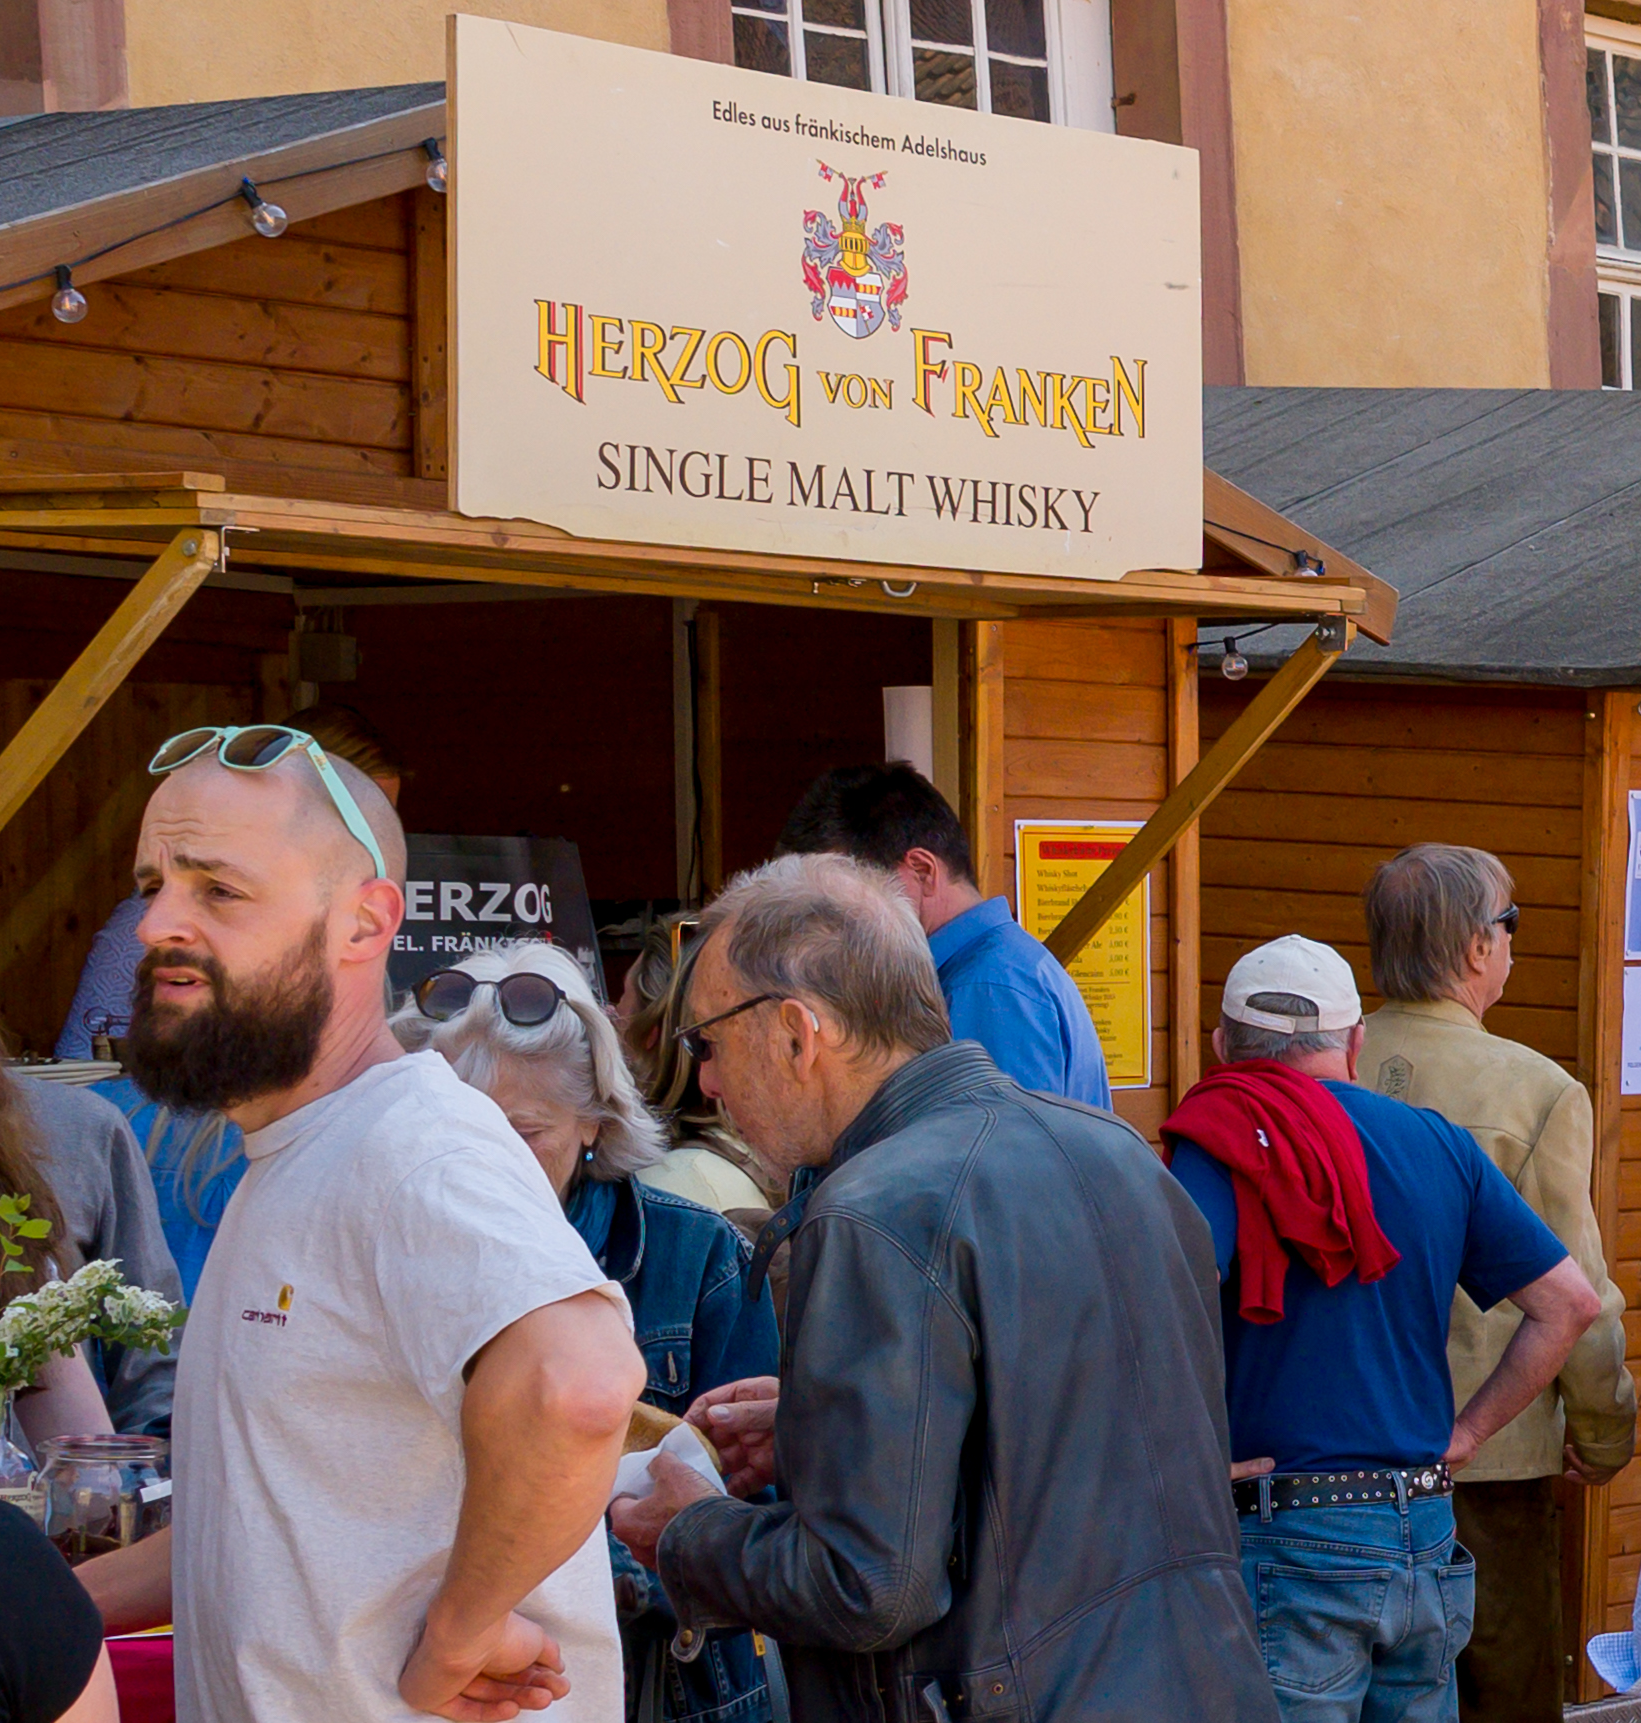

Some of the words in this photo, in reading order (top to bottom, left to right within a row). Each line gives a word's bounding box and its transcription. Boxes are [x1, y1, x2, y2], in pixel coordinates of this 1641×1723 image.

[712, 100, 756, 128] Edles
[761, 115, 790, 134] aus
[795, 113, 896, 152] fränkischem
[902, 134, 987, 165] Adelshaus
[533, 299, 801, 429] HERZOG
[910, 328, 1148, 448] FRANKEN
[597, 442, 774, 504] SINGLE
[787, 461, 915, 517] MALT
[926, 475, 1101, 533] WHISKY
[405, 881, 553, 923] ERZOG
